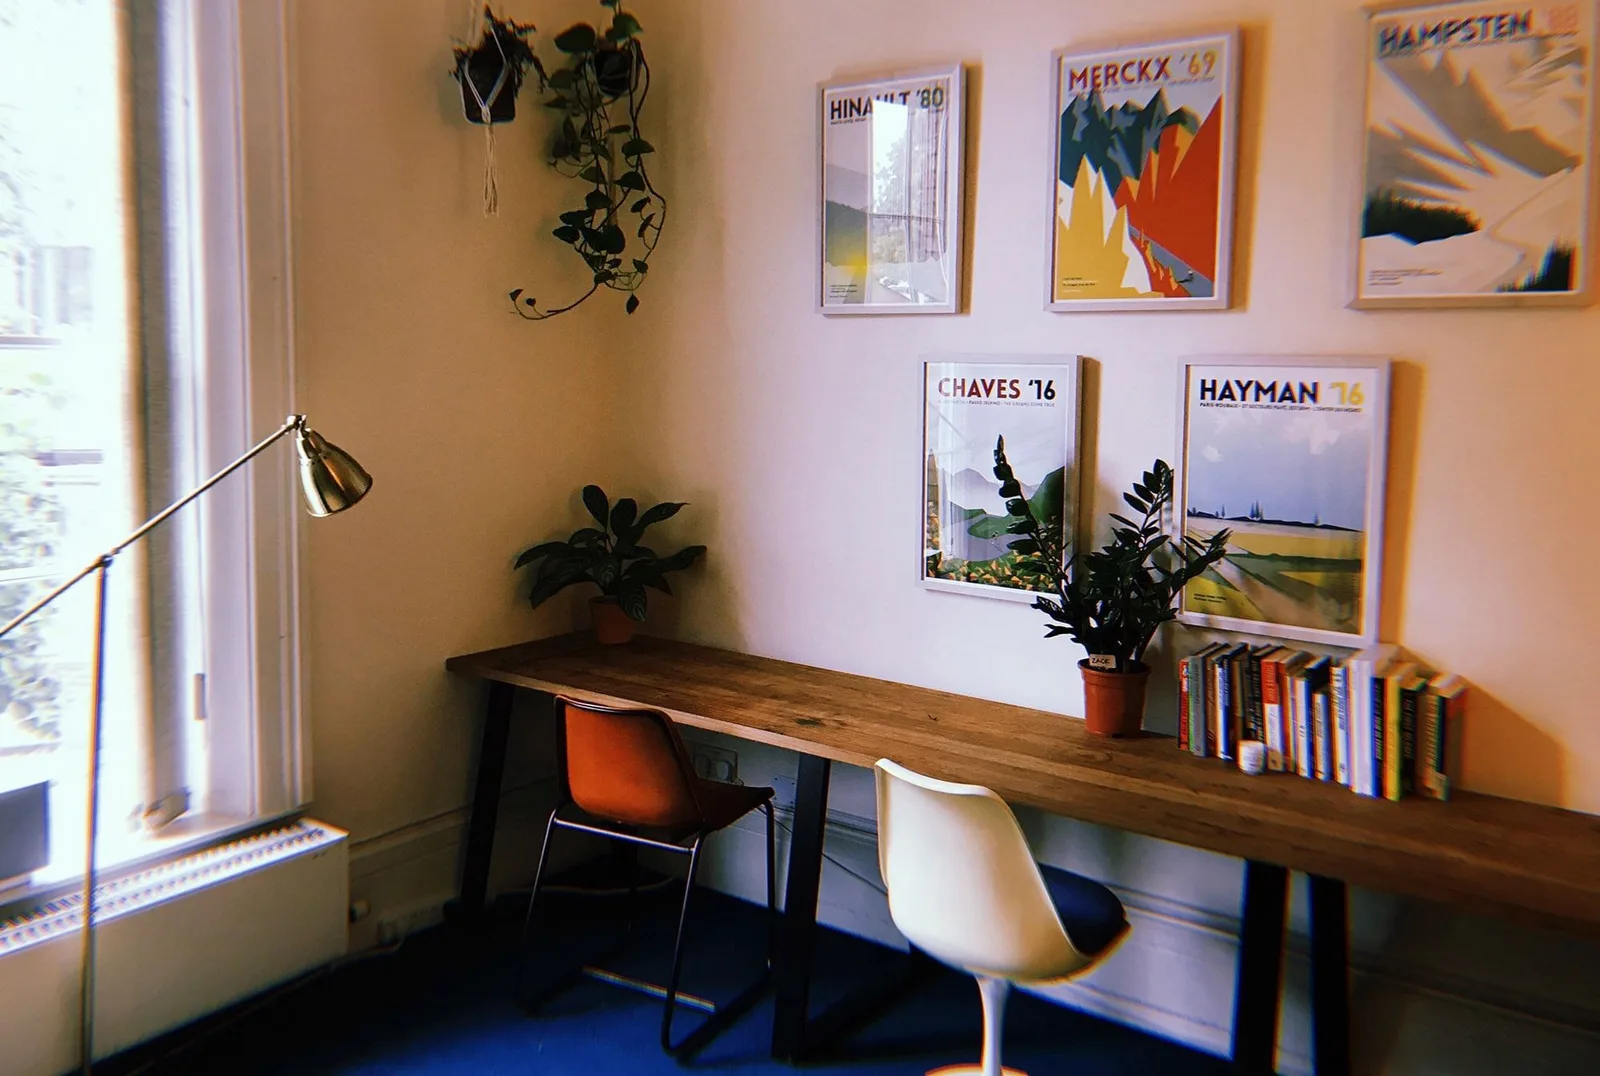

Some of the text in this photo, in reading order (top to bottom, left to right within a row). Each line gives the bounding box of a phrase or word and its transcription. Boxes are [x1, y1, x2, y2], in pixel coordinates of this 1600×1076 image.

[1378, 9, 1532, 53] HAMPSTEN
[1069, 54, 1172, 91] MERCKX
[1179, 51, 1217, 76] '69
[916, 86, 944, 109] '80
[938, 378, 1056, 400] CHAVES '16
[1200, 379, 1319, 403] HAYMAN
